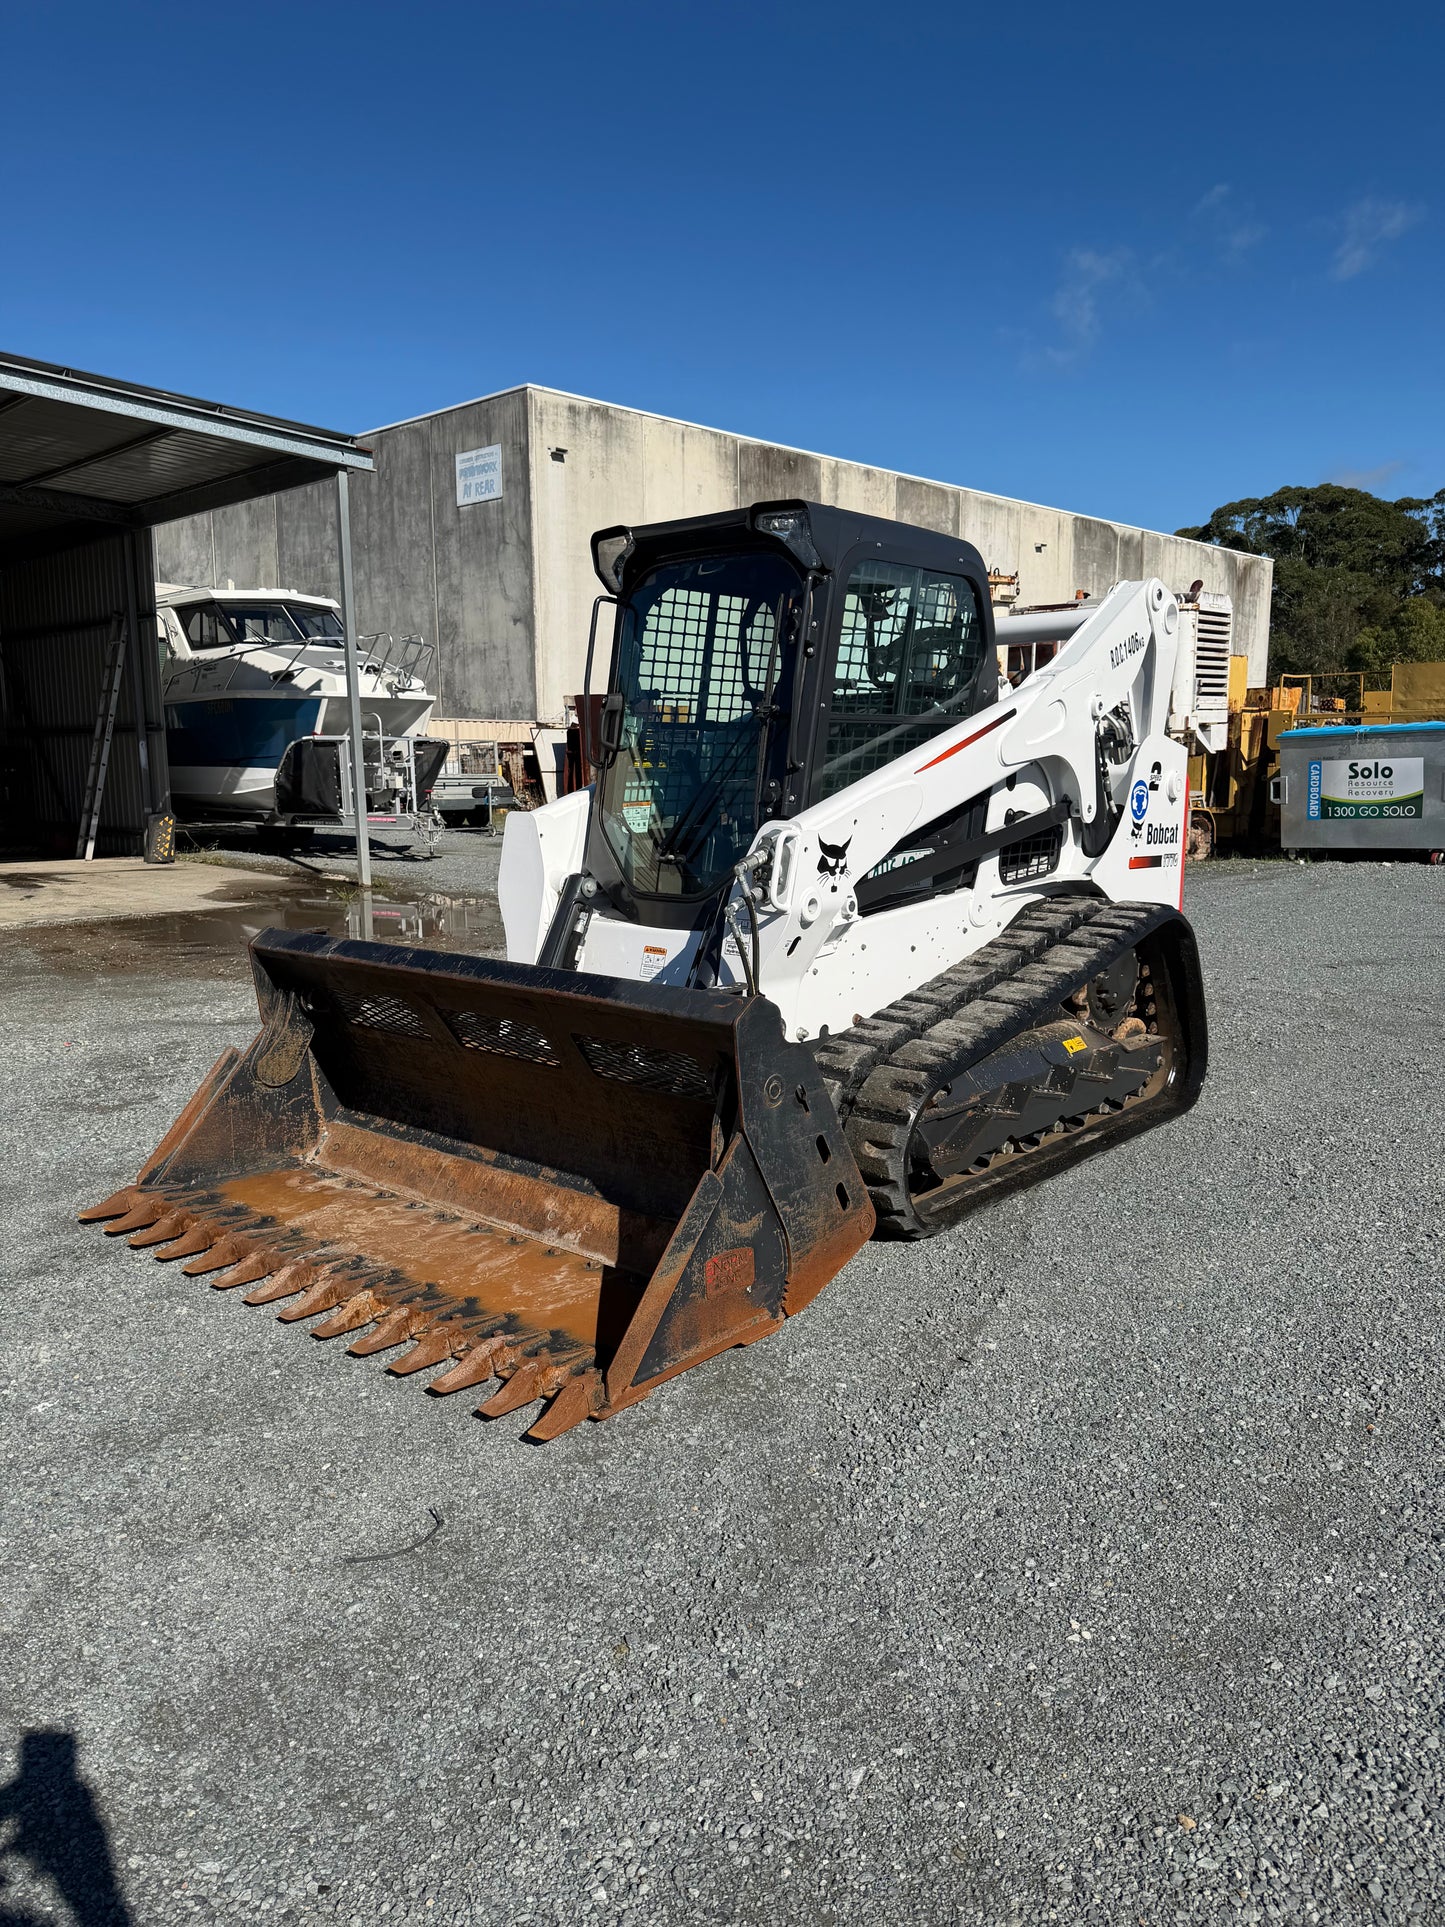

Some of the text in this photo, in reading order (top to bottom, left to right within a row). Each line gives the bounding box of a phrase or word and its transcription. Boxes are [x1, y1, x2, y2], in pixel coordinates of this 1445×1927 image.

[475, 479, 496, 497] REAR
[1348, 761, 1394, 779] Solo
[1309, 764, 1320, 817] CARDBOARD
[1348, 789, 1394, 797] Recovery
[1327, 805, 1416, 817] 1300 GO SOLO
[1146, 823, 1179, 845] Bobcat
